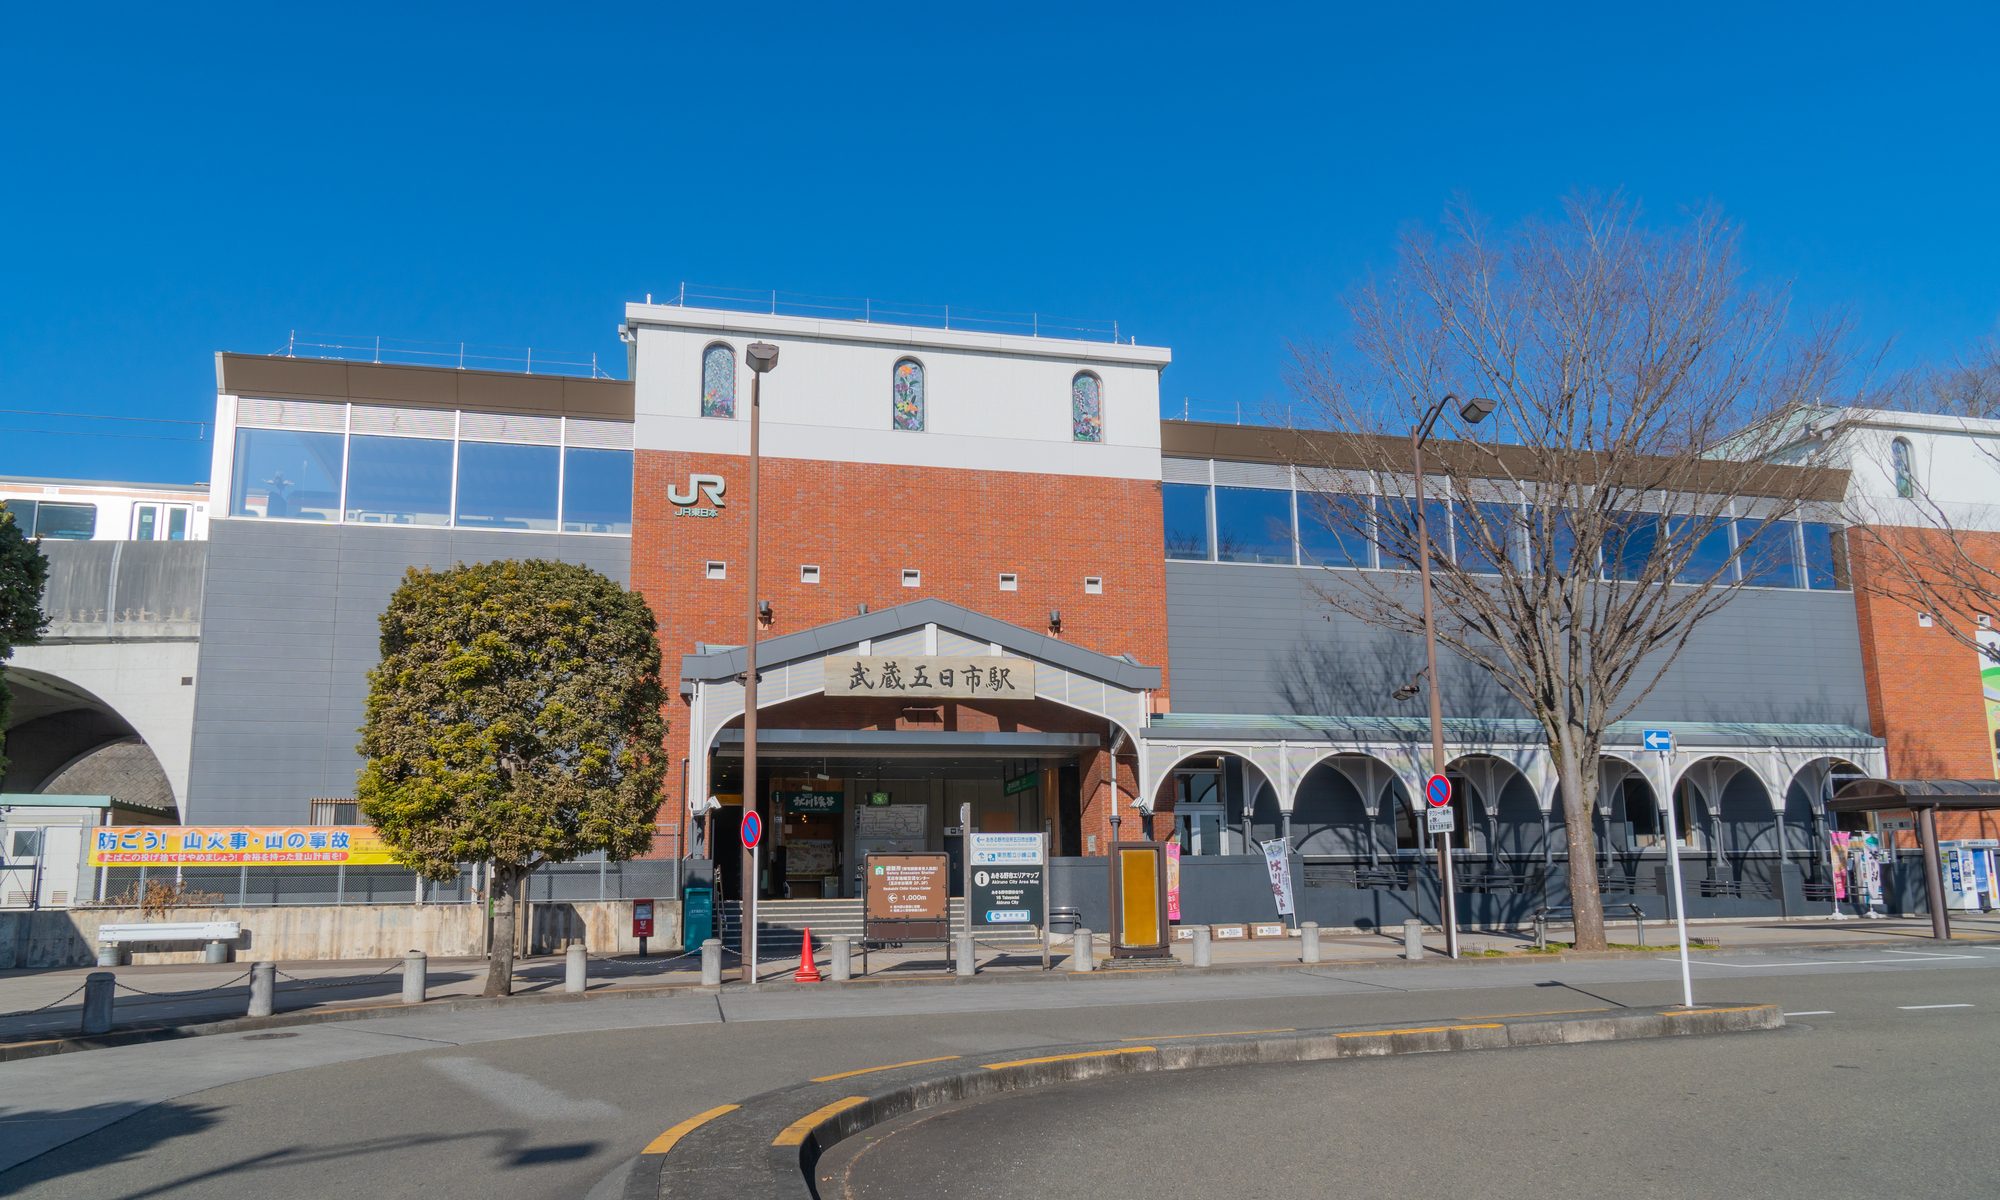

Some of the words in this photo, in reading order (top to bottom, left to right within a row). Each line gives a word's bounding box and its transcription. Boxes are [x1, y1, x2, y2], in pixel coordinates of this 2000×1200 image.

[667, 473, 726, 505] JR
[848, 661, 1016, 694] 武蔵五日市駅
[183, 831, 350, 851] 山火事・山の事故
